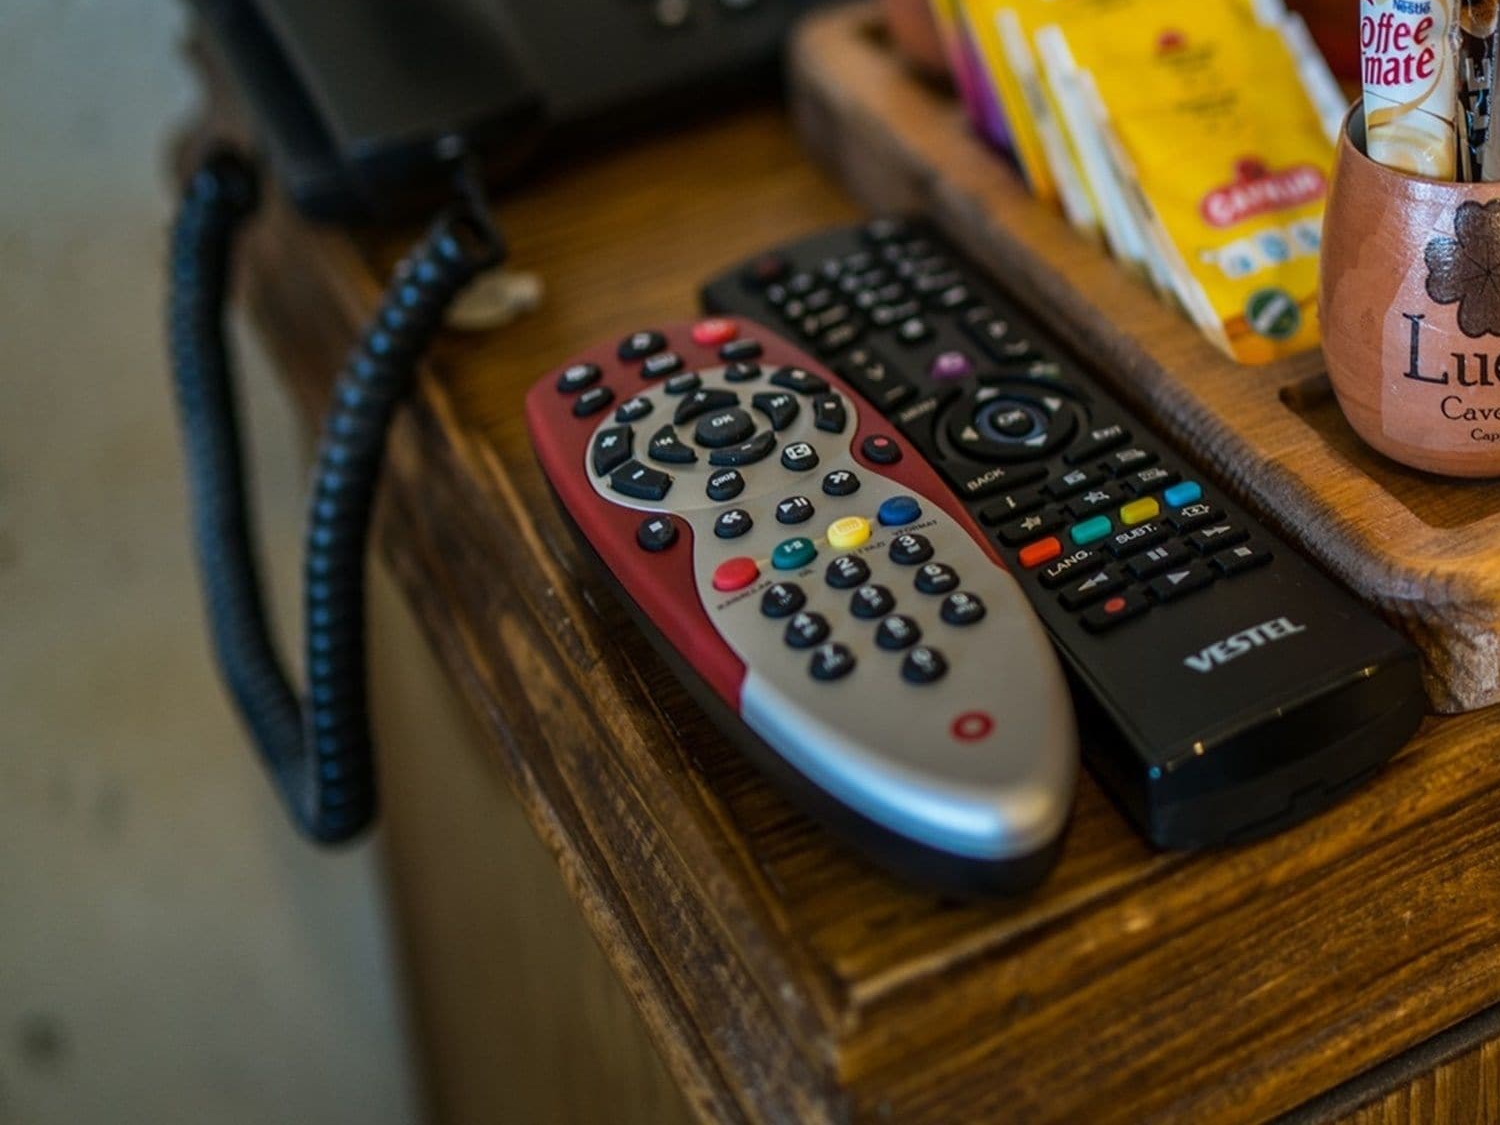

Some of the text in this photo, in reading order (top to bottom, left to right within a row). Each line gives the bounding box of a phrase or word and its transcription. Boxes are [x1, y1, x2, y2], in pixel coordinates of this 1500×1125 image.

[1364, 47, 1435, 85] mate
[711, 414, 735, 427] OK
[967, 468, 1005, 491] BACK
[1184, 616, 1306, 674] VESTEL
